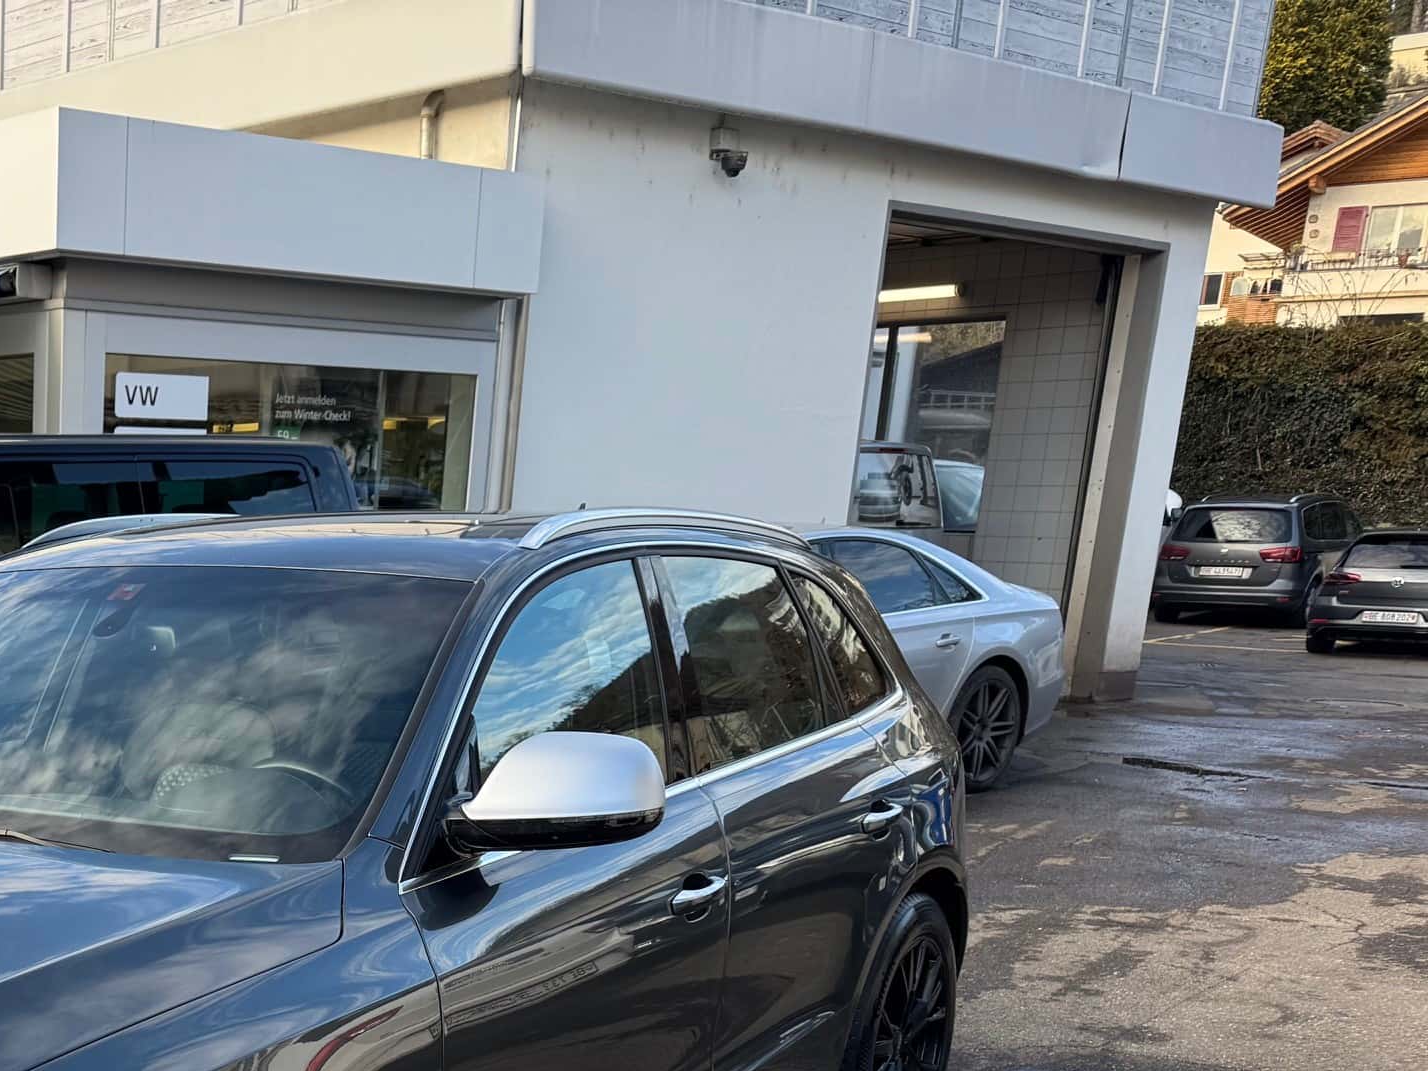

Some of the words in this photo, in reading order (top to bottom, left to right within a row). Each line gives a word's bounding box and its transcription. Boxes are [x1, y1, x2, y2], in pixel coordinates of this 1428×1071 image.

[124, 384, 159, 406] VW
[275, 393, 295, 404] Jetzt
[297, 394, 336, 406] anmelden
[275, 410, 293, 419] zum
